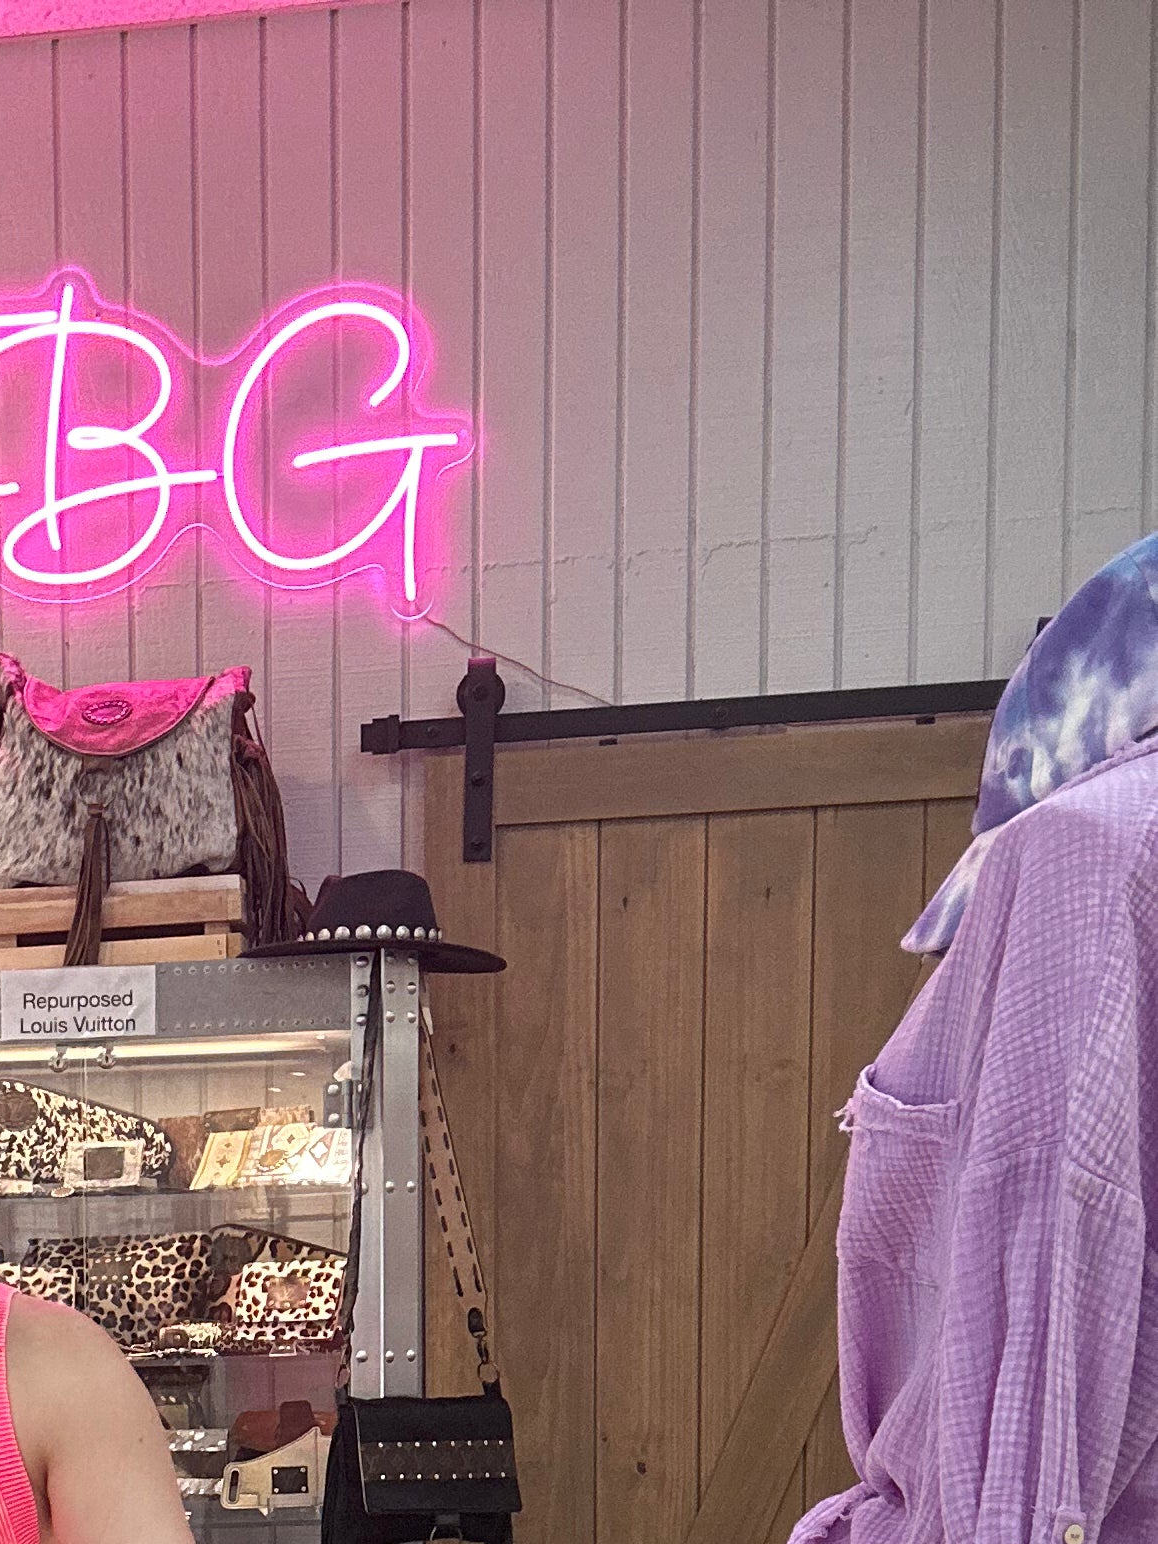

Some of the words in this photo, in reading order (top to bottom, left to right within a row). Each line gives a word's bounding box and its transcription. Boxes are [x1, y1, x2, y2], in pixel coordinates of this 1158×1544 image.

[23, 990, 133, 1012] Repurposed
[20, 1017, 68, 1034] Louis
[73, 1016, 136, 1033] Vuitton
